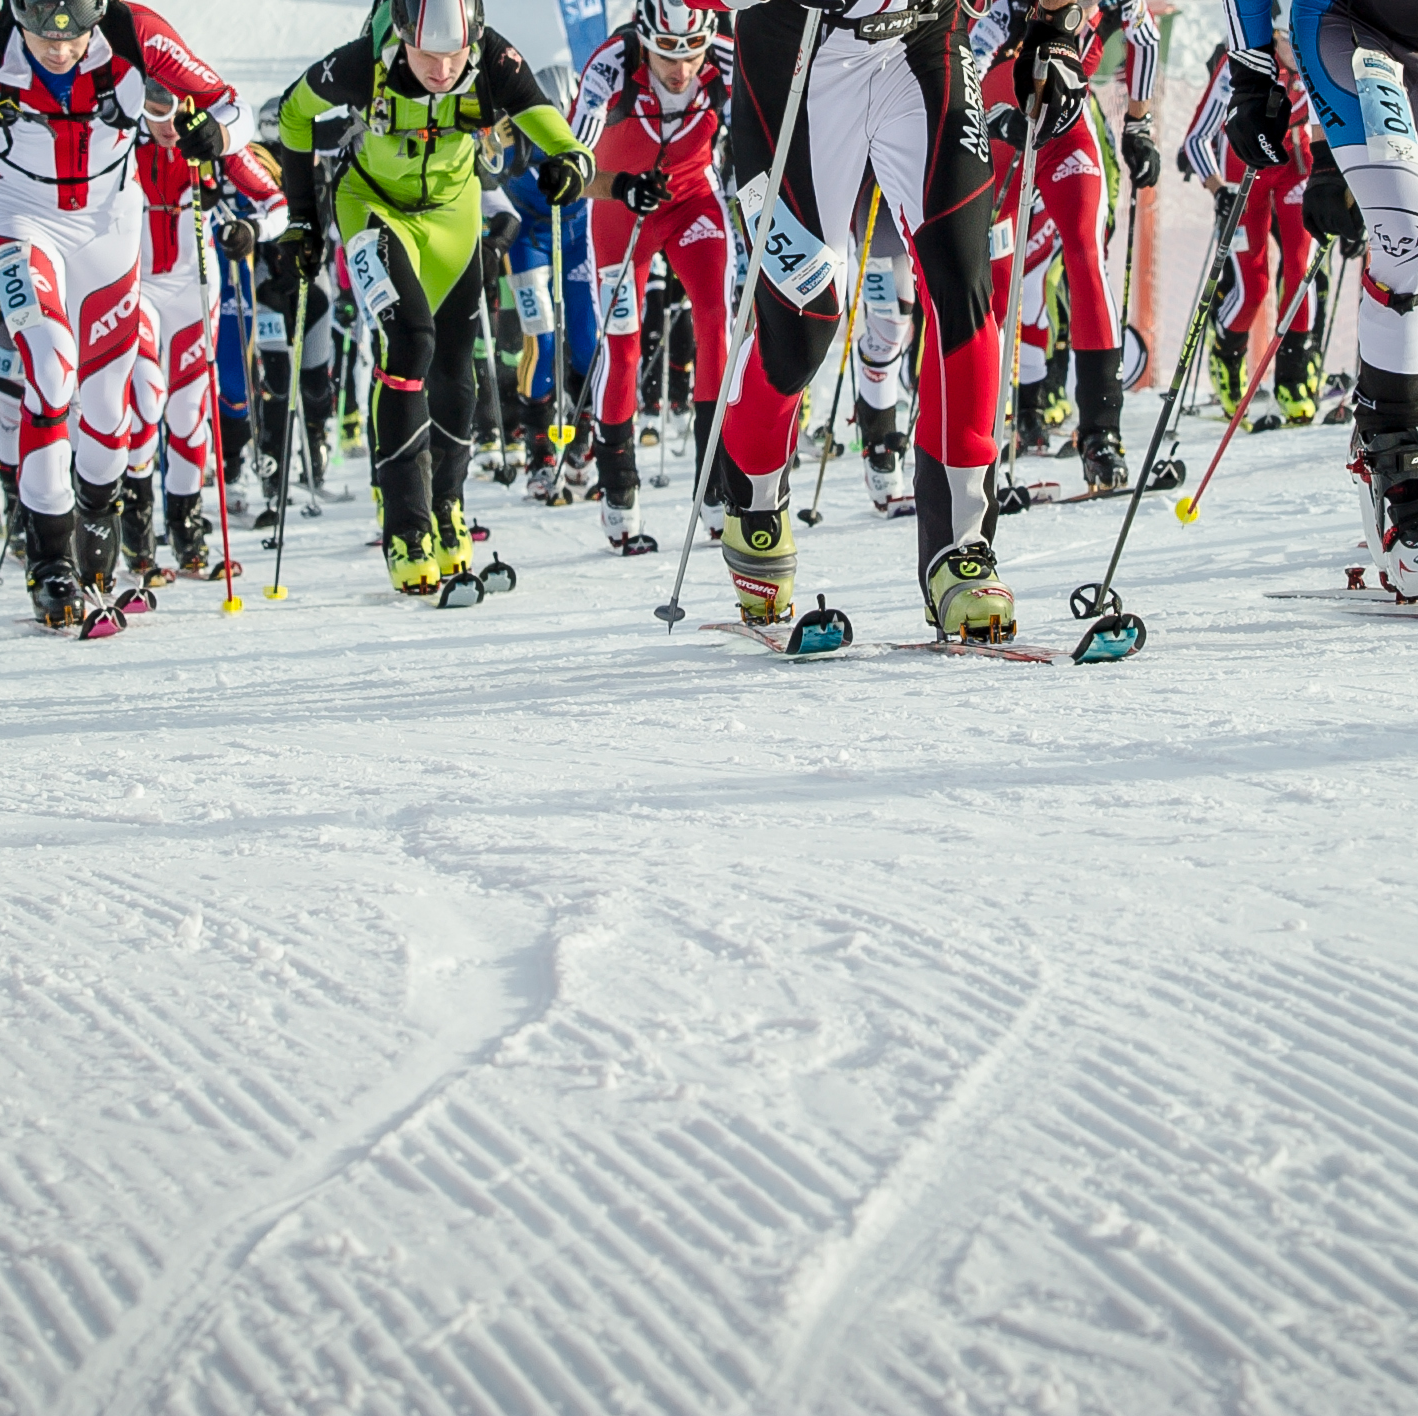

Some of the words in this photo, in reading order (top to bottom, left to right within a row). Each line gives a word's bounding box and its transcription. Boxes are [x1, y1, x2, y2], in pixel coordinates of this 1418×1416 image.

[862, 16, 916, 34] CAMP
[144, 33, 220, 86] ATOMIC
[958, 44, 983, 155] MARTINI
[1376, 84, 1410, 136] 041
[1052, 164, 1101, 183] adidas
[678, 228, 726, 248] adidas
[353, 248, 372, 290] 021
[3, 263, 28, 310] 004
[866, 273, 886, 302] 011
[519, 287, 538, 320] 203
[734, 577, 777, 596] ATOMIC
